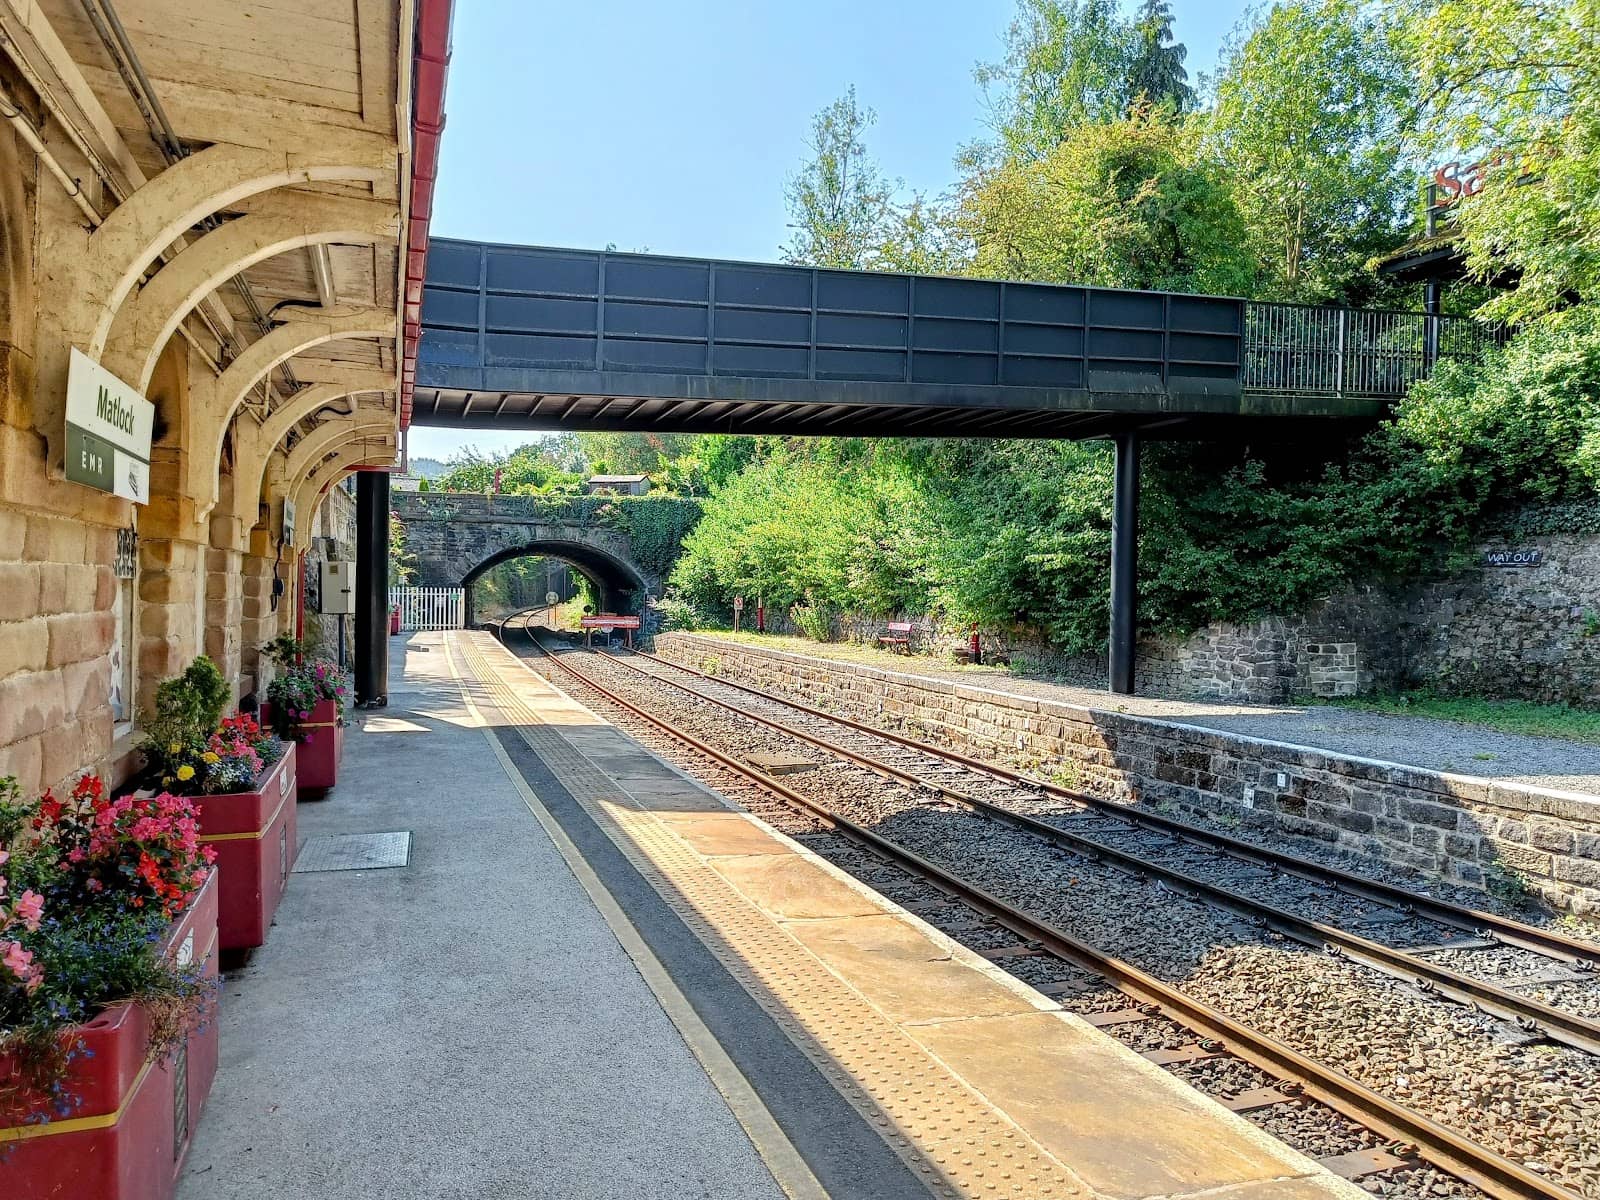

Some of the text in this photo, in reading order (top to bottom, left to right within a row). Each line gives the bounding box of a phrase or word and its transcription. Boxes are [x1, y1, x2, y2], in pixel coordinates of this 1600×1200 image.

[97, 384, 135, 436] Matlock
[82, 450, 103, 475] EMR
[1487, 552, 1538, 562] WAY OUT
